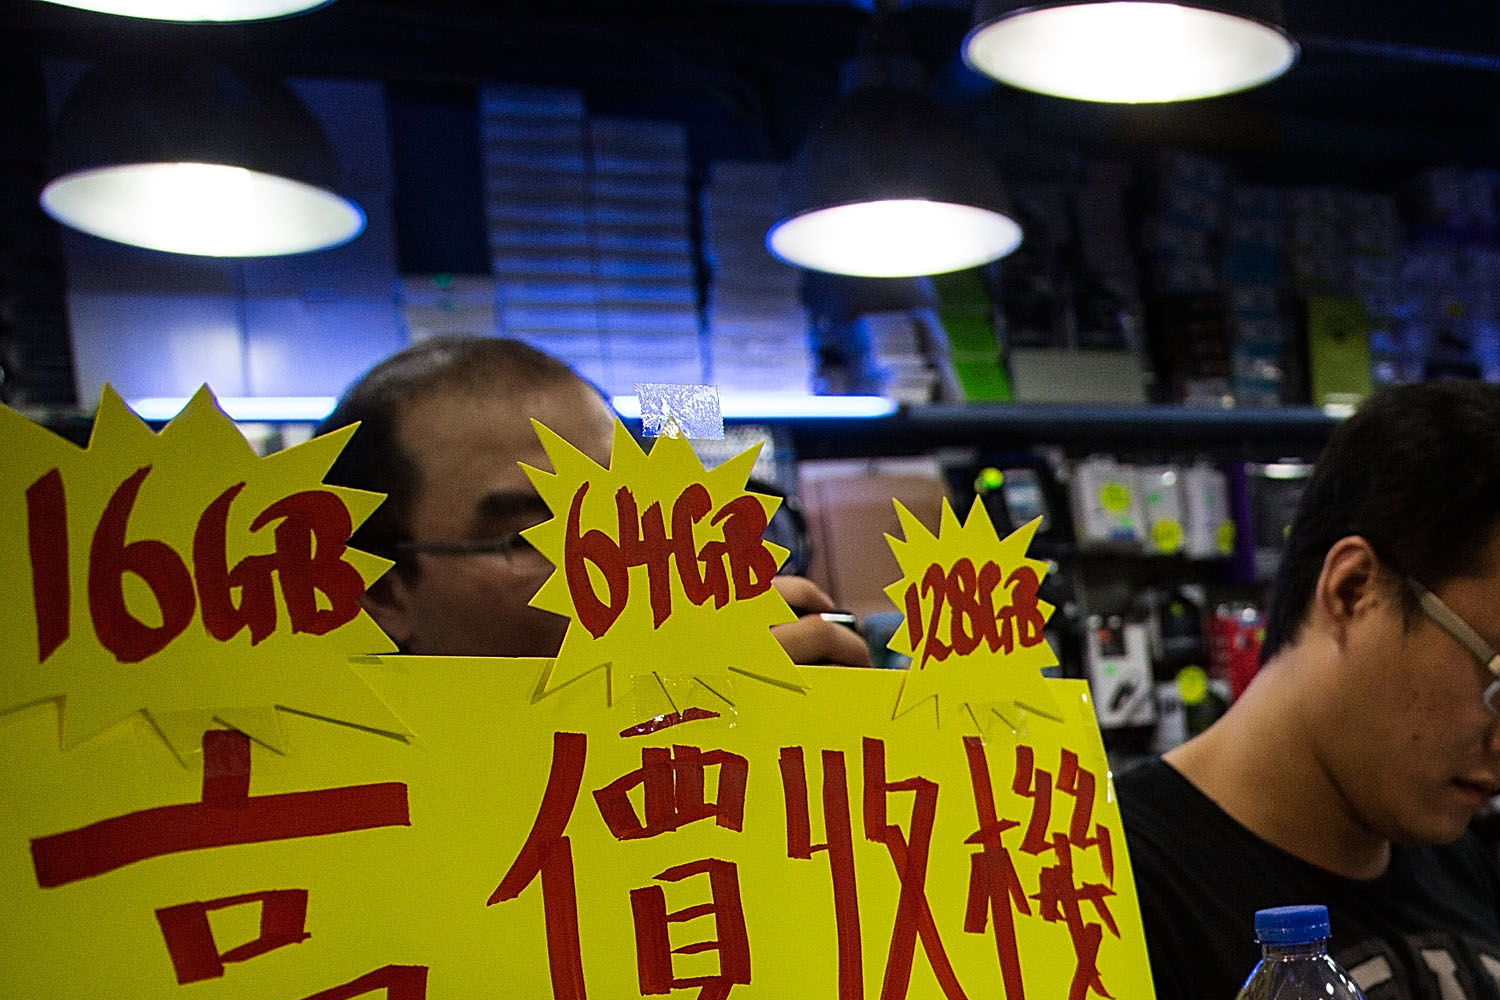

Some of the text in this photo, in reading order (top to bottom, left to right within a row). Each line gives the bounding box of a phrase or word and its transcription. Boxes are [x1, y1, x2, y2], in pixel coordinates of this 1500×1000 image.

[26, 466, 366, 664] 16GB
[564, 481, 777, 640] 64GB
[904, 556, 1045, 670] 128GB
